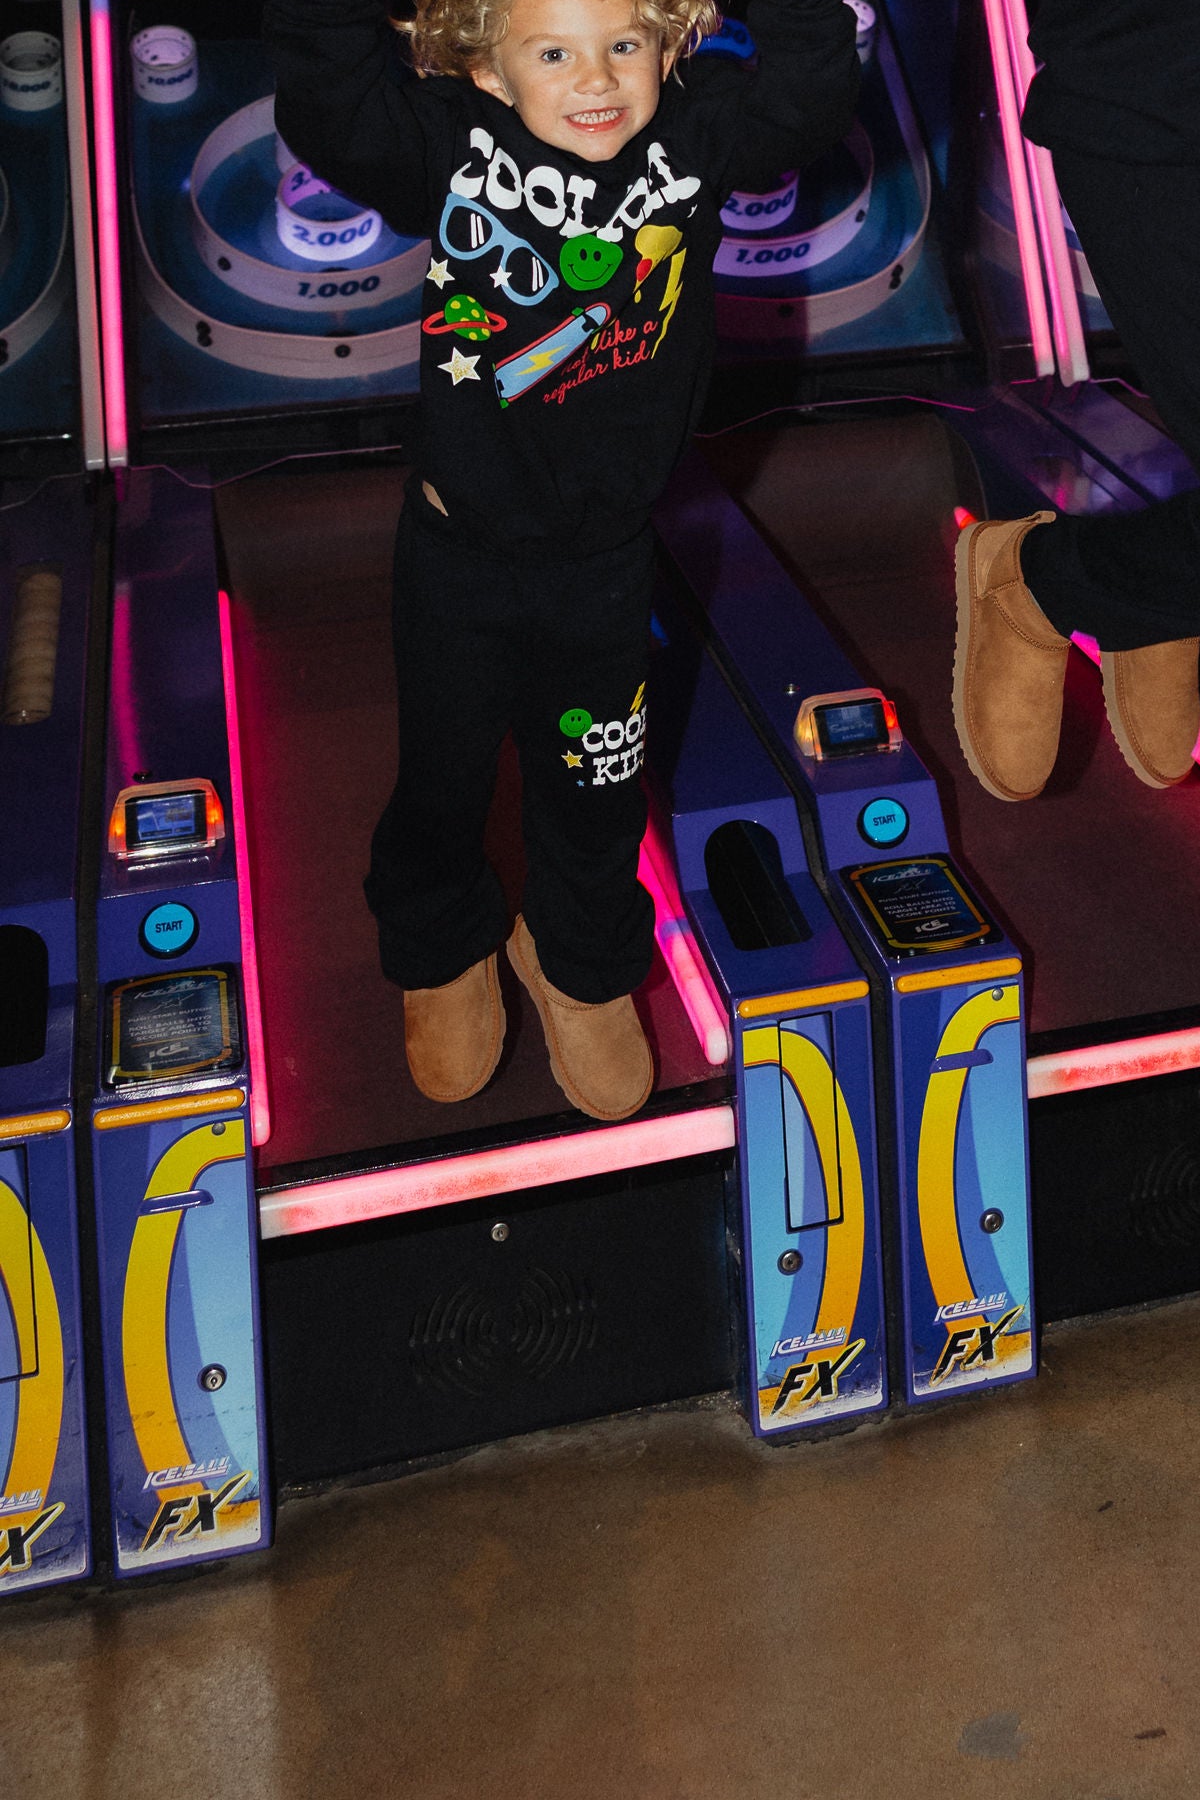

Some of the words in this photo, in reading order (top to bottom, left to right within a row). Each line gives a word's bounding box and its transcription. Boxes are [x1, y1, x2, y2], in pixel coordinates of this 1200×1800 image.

[450, 127, 600, 239] COOL
[594, 319, 637, 354] like
[643, 320, 658, 334] a
[543, 363, 608, 405] regular
[612, 340, 651, 370] kid
[872, 813, 897, 827] START
[155, 919, 183, 934] START
[914, 920, 950, 933] ICE
[149, 1042, 189, 1058] ICE
[770, 1338, 866, 1417] FX
[930, 1304, 1025, 1387] FX
[0, 1502, 64, 1575] X
[141, 1471, 252, 1551] FX
